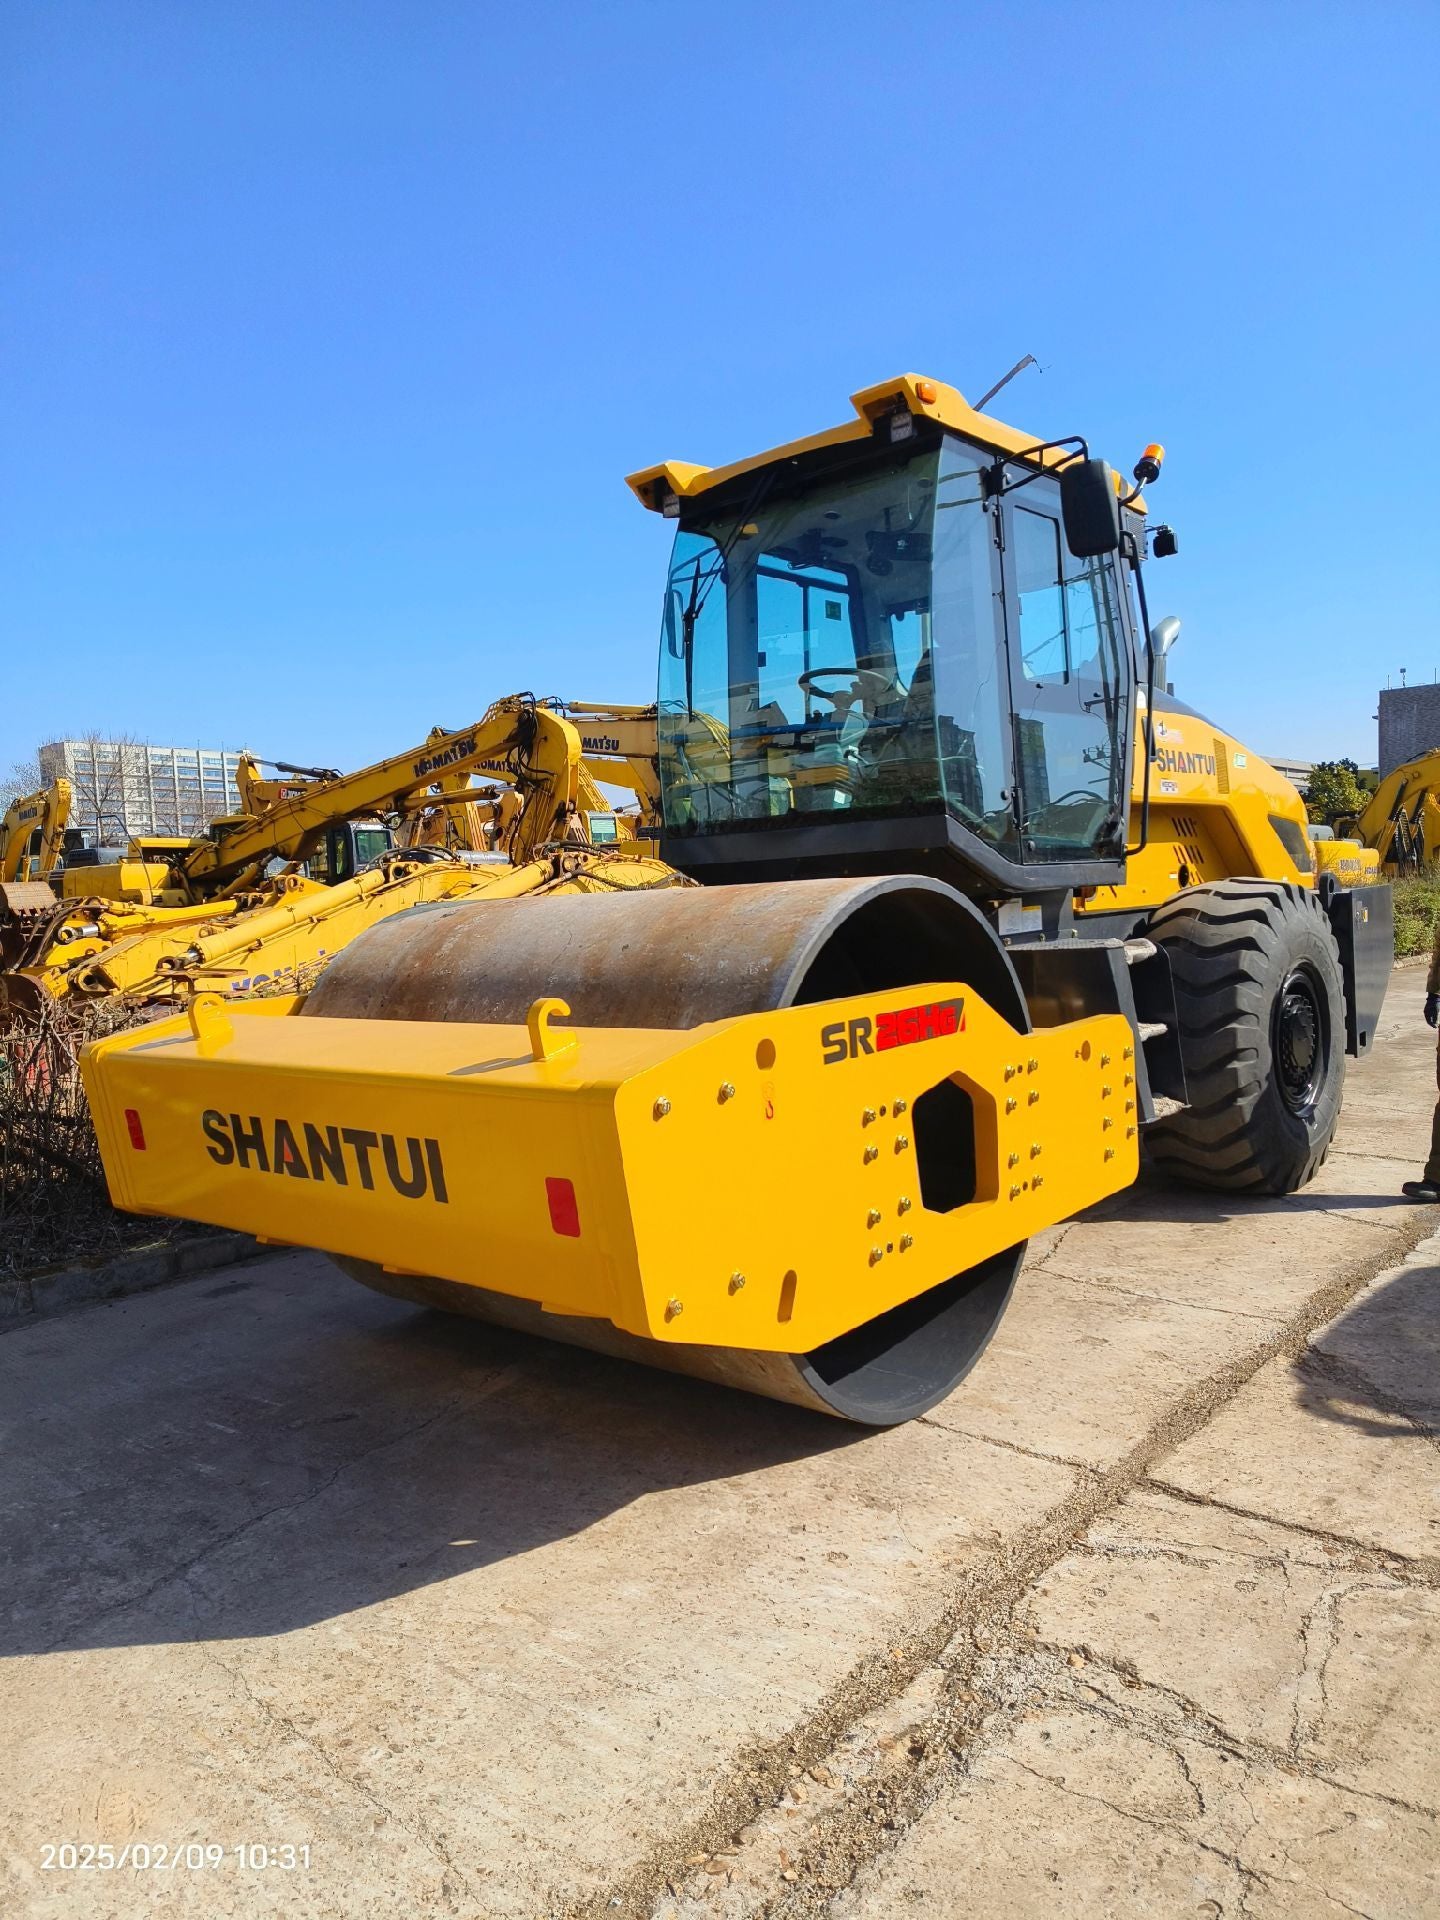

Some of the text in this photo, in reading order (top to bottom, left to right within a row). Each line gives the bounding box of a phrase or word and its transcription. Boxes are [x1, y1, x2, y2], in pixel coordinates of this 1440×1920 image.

[413, 739, 477, 778] KOMATSU
[1156, 747, 1216, 777] SHANTUI
[202, 1108, 449, 1204] SHANTUI
